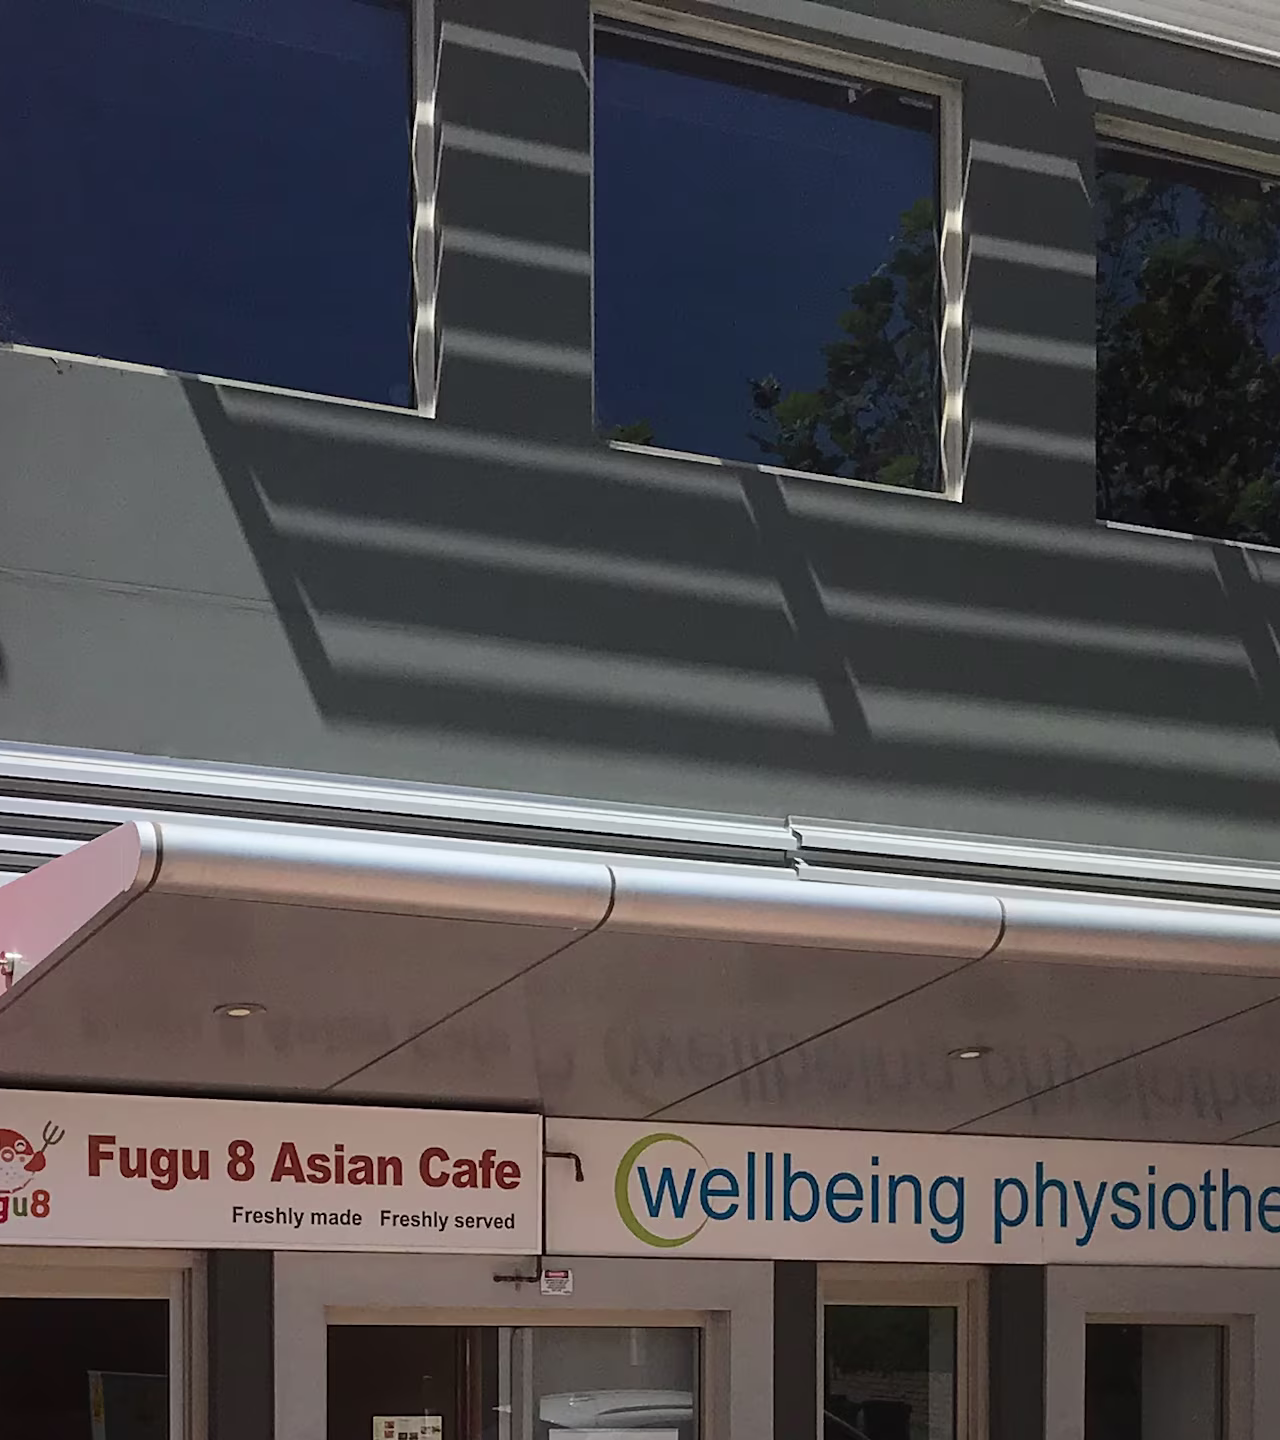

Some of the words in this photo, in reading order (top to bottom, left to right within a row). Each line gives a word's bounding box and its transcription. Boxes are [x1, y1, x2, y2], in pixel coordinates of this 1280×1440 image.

[87, 1134, 210, 1190] Fugu
[226, 1139, 255, 1182] 8
[270, 1141, 404, 1186] Asian
[419, 1146, 522, 1190] Cafe
[232, 1206, 304, 1229] Freshly
[310, 1208, 363, 1226] made
[379, 1209, 449, 1231] Freshly
[453, 1213, 516, 1229] served
[637, 1151, 965, 1245] wellbeing
